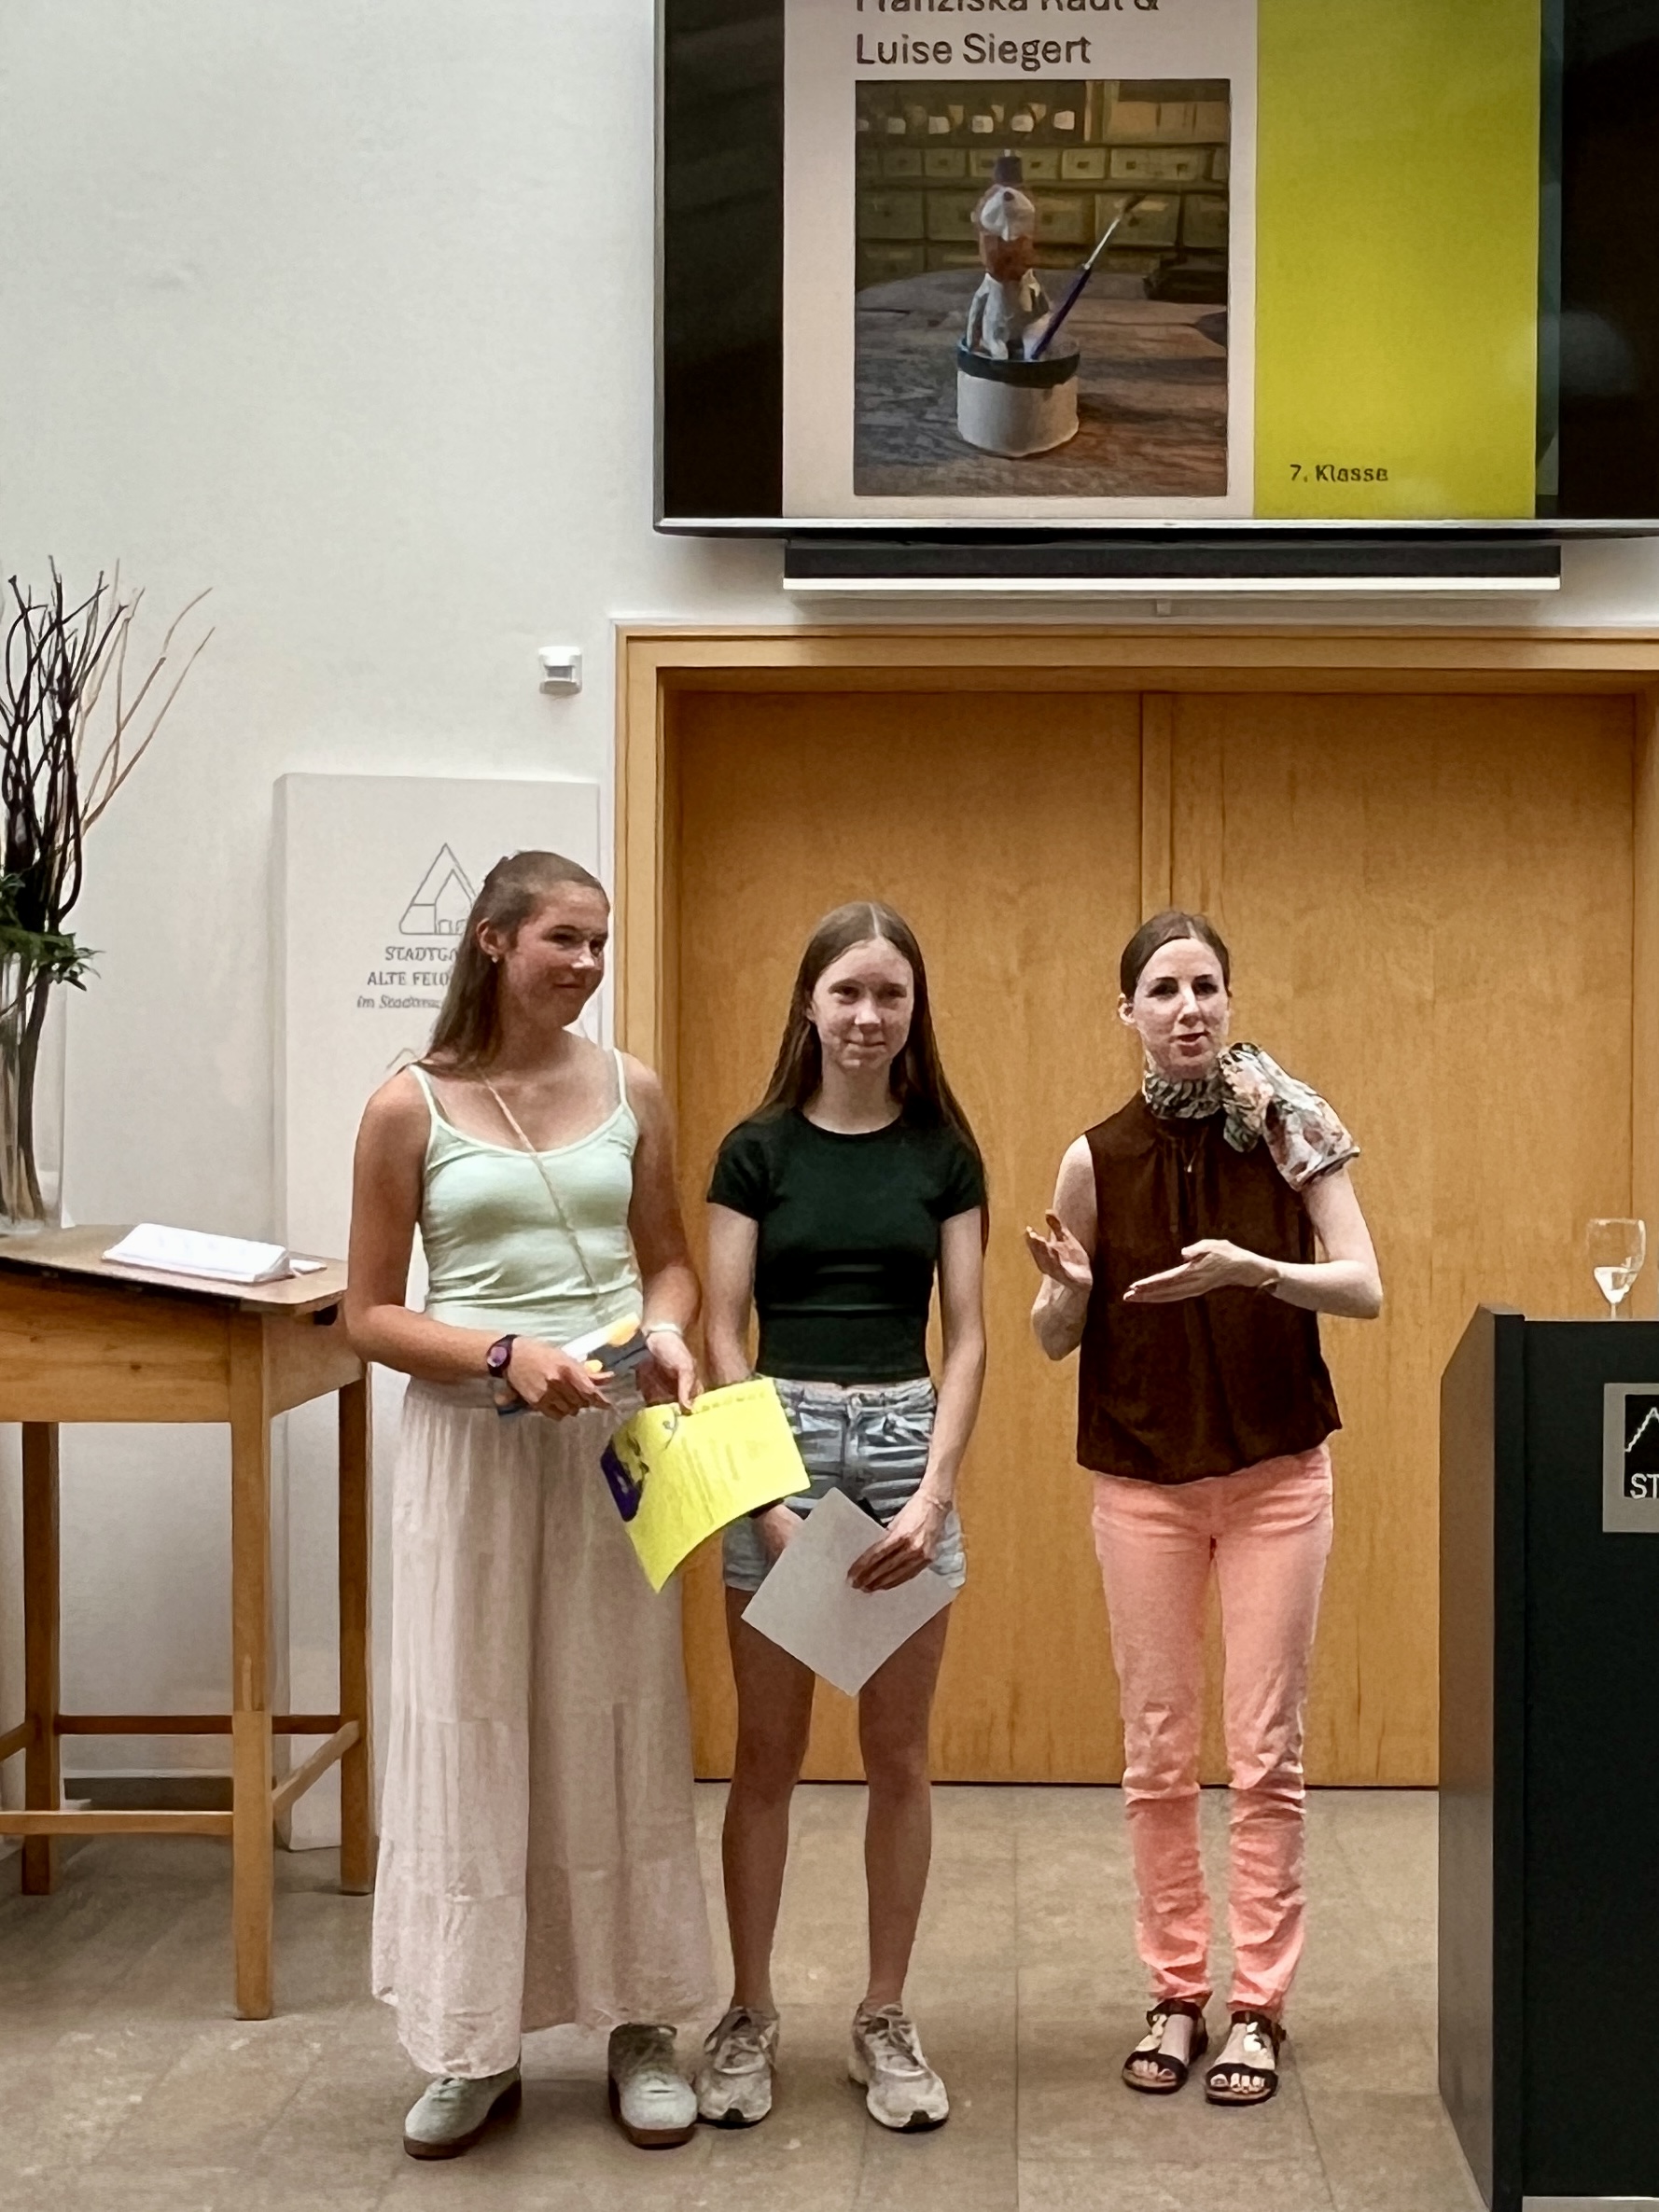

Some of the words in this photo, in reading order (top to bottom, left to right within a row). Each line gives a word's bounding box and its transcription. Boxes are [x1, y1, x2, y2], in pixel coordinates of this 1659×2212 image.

[856, 33, 953, 64] Luise
[963, 33, 1092, 72] Siegert
[1290, 464, 1308, 482] 7.
[1315, 464, 1388, 482] Klasse
[367, 971, 407, 986] ALTE
[1630, 1472, 1659, 1499] ST
